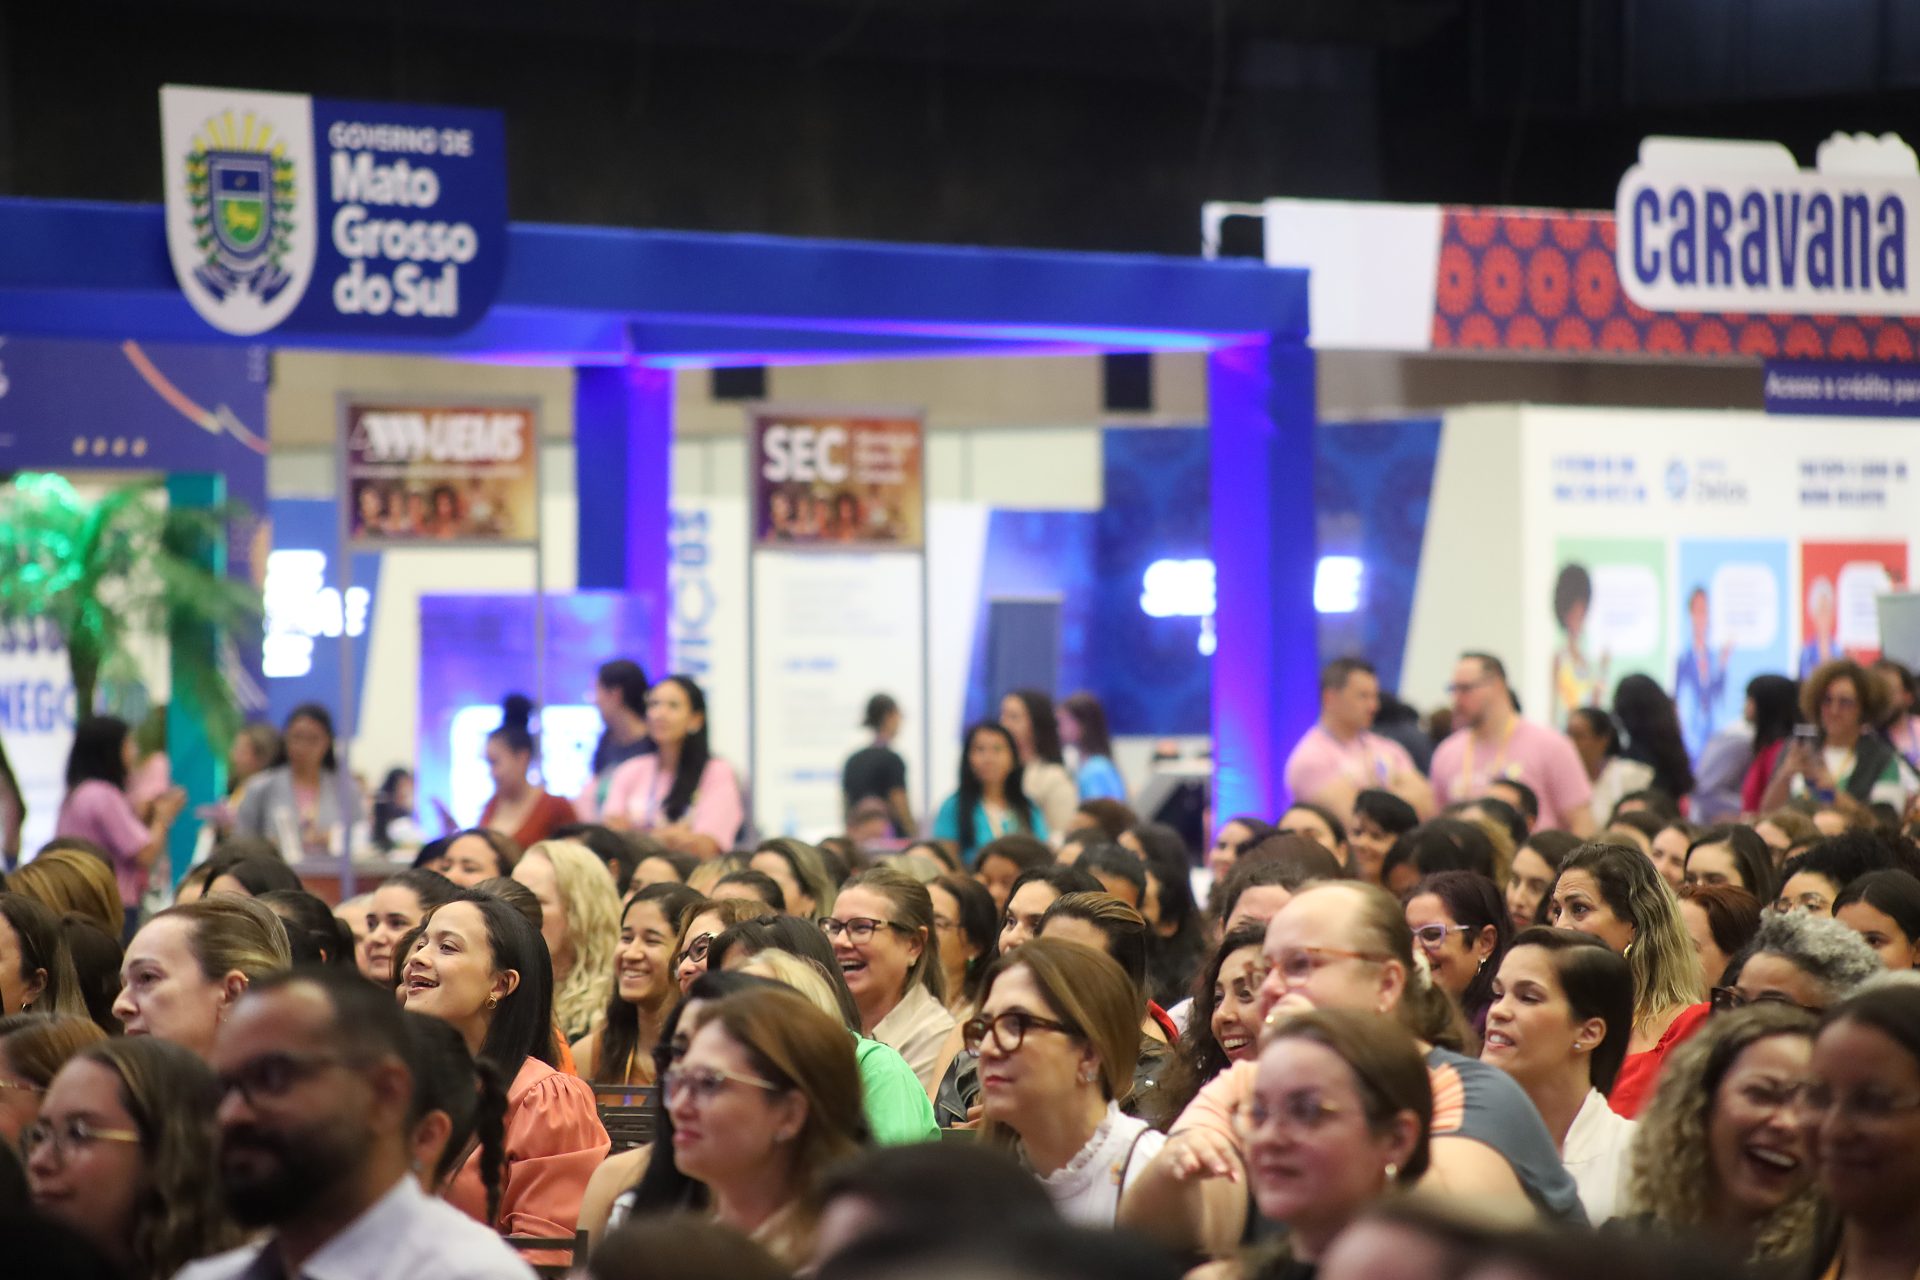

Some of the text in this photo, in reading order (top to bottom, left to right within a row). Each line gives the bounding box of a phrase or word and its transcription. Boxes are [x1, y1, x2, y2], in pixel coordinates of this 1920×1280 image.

[328, 121, 474, 157] GOVERNO DE
[331, 151, 439, 208] Mato
[332, 204, 479, 263] Grosso
[333, 258, 459, 318] do Sul
[762, 424, 847, 482] SEC
